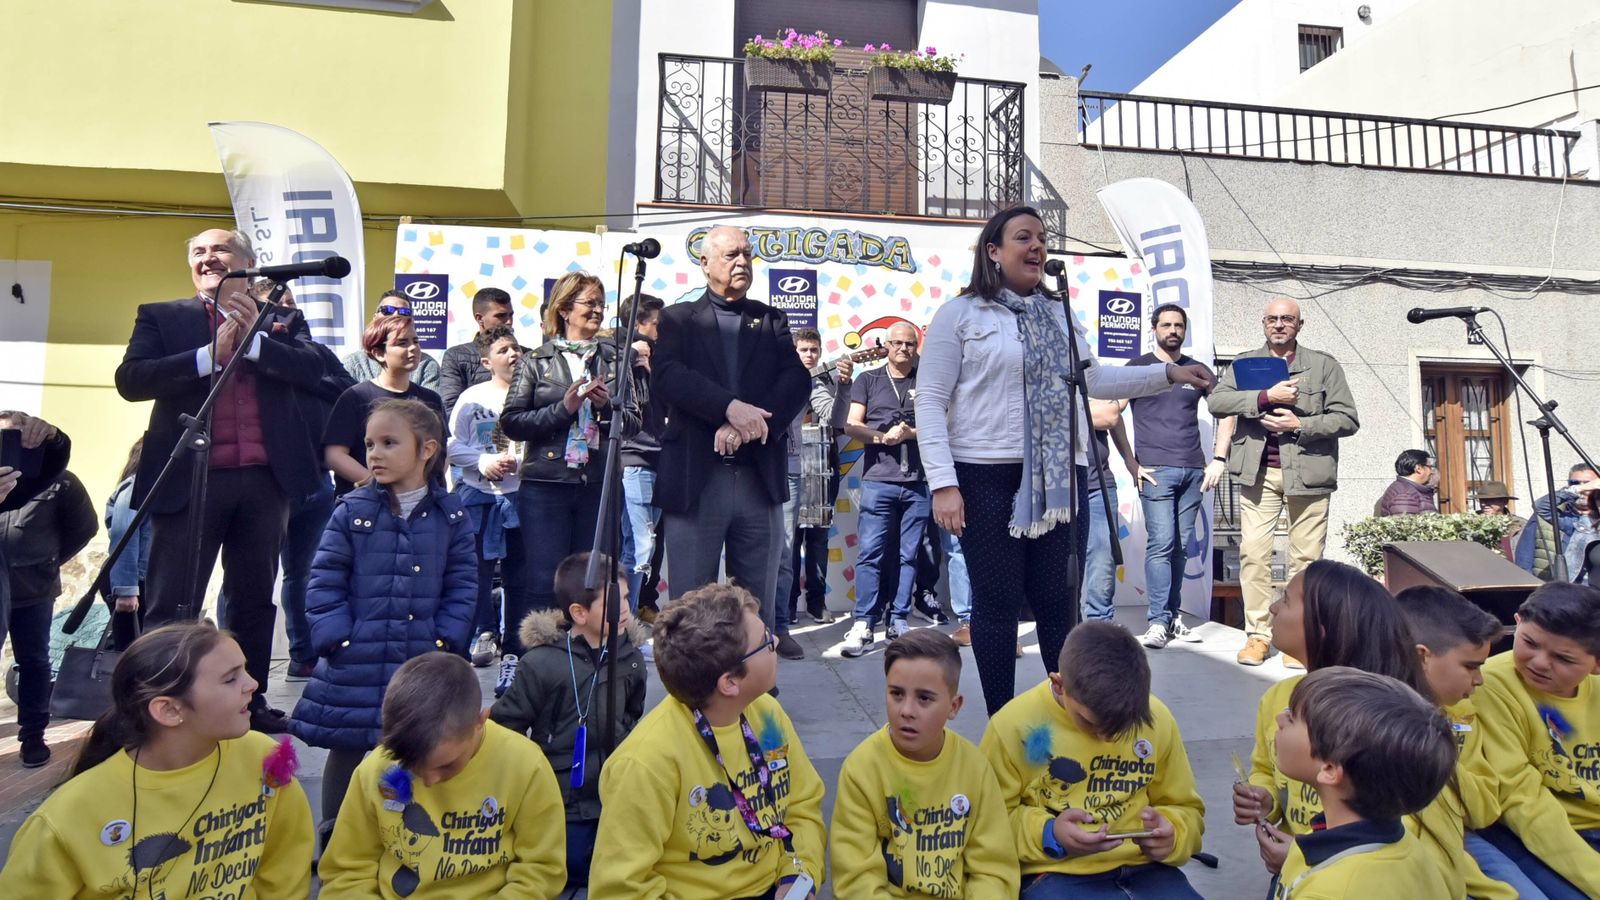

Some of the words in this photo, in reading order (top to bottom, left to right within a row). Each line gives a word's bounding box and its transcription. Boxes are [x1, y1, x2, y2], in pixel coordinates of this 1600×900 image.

[687, 228, 916, 271] TIGADA
[411, 301, 447, 309] UNDAI
[771, 294, 817, 303] HYUNDAI
[1100, 314, 1141, 325] HYUNDAI
[1100, 321, 1140, 331] PERMOTOR
[1090, 754, 1155, 776] Chirigota
[1301, 783, 1318, 806] No
[193, 794, 266, 837] Chirigot
[441, 807, 505, 833] Chirigot
[1290, 806, 1309, 826] ni
[193, 816, 266, 866] Infanti
[433, 856, 456, 881] No
[915, 854, 931, 878] No
[185, 868, 209, 899] No
